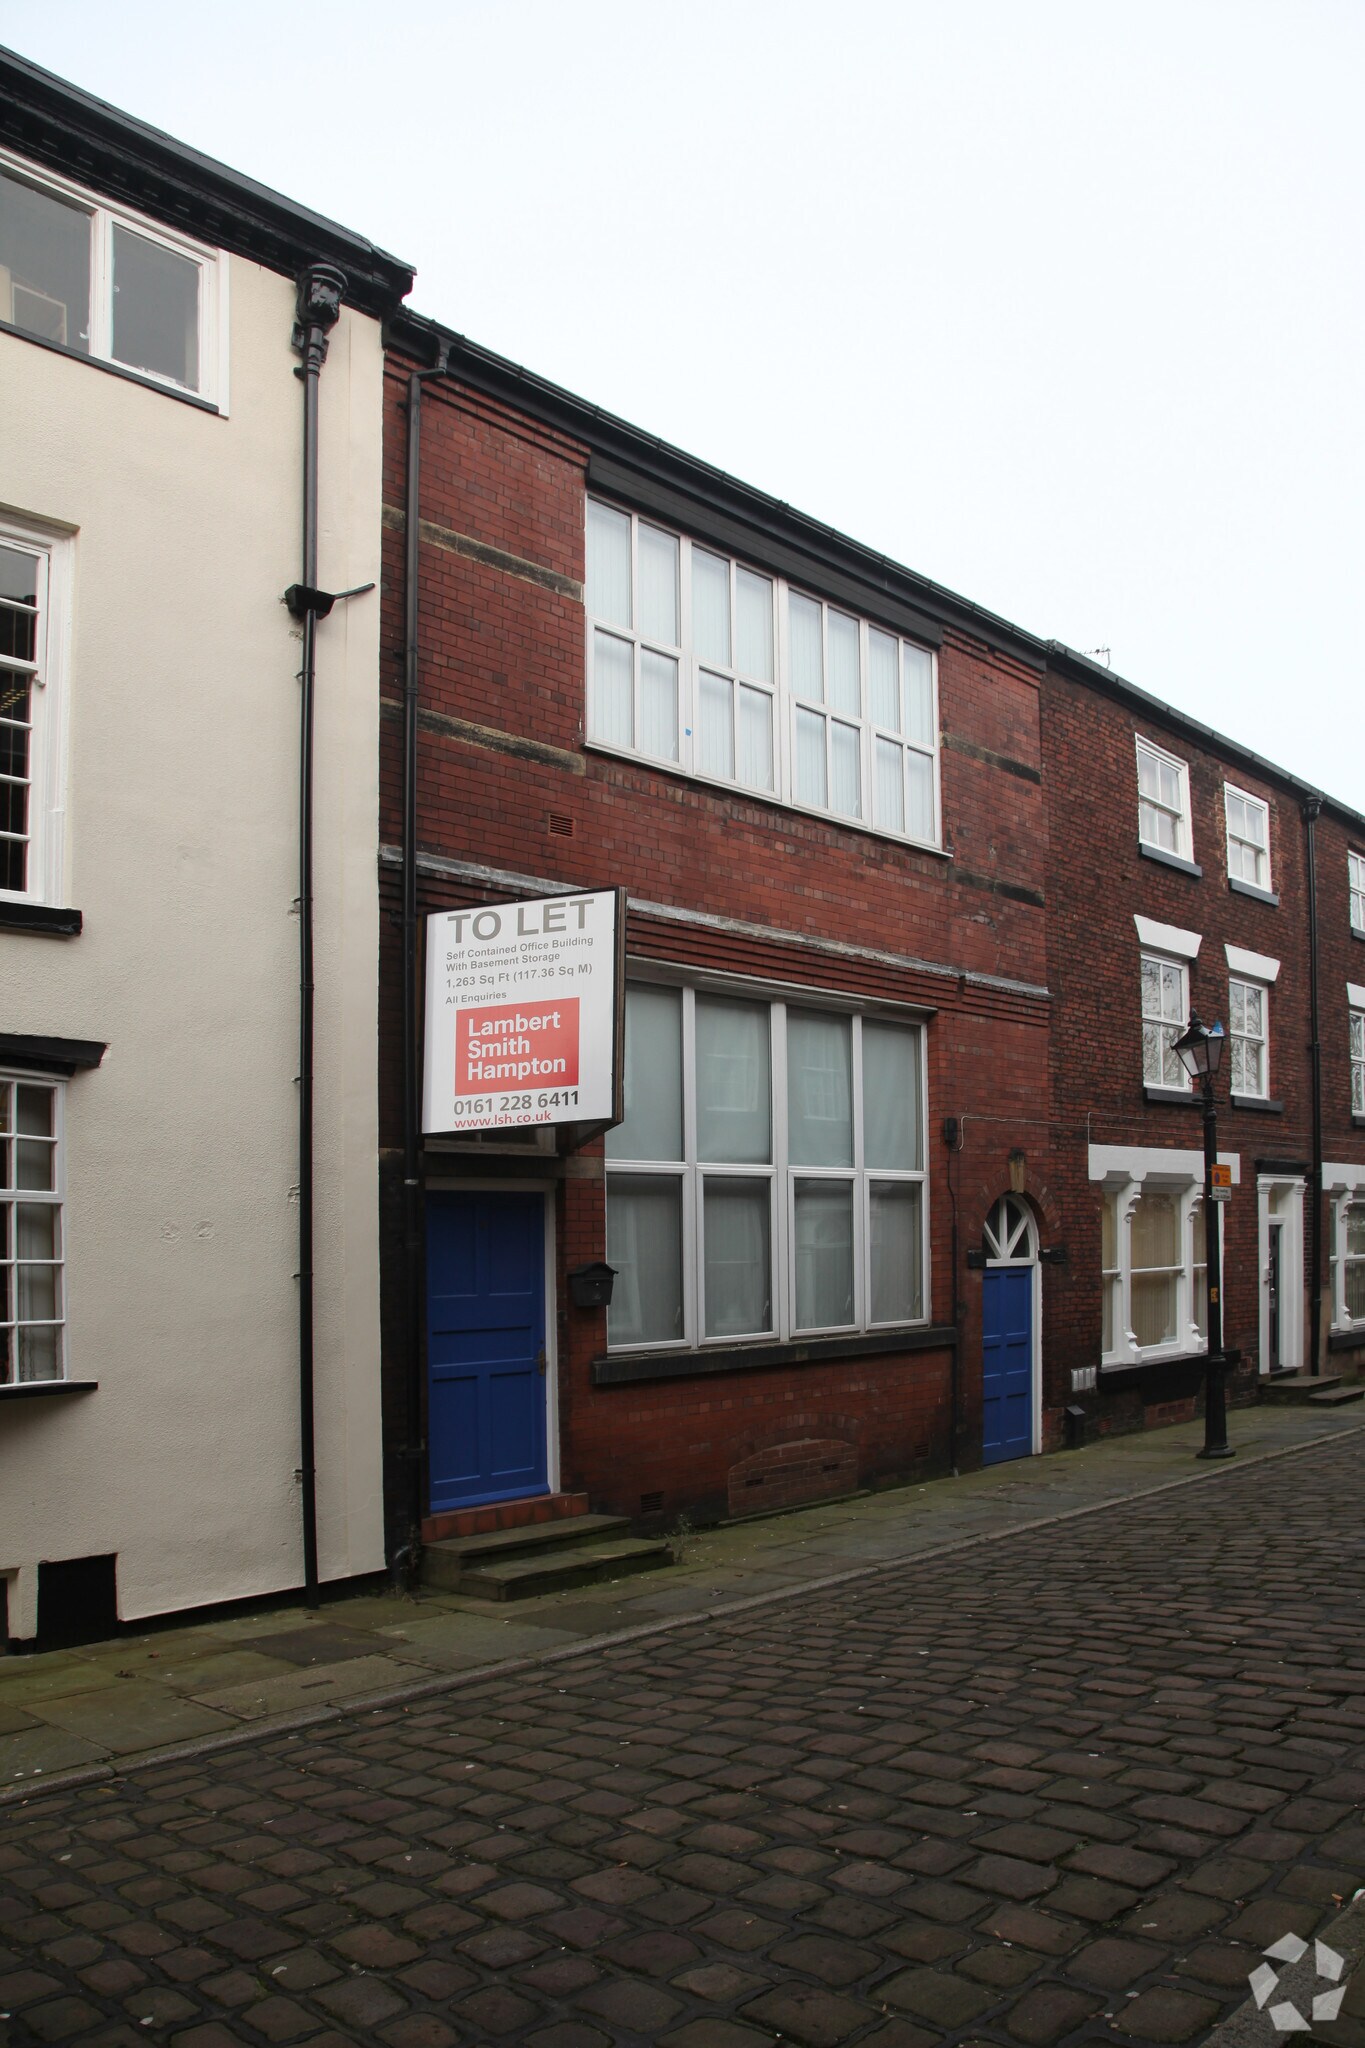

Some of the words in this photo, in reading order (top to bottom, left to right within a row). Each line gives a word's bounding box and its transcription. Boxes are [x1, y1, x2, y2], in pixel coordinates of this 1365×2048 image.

[447, 911, 502, 943] TO
[517, 899, 595, 936] LET
[446, 950, 465, 961] Self
[467, 945, 517, 958] Contained
[519, 942, 549, 952] Office
[552, 936, 594, 948] Building
[446, 963, 468, 972] With
[470, 954, 519, 969] Basement
[521, 952, 560, 964] Storage
[446, 976, 476, 988] 1,263
[479, 974, 495, 985] Sq
[498, 972, 510, 982] Ft
[513, 967, 555, 983] (117.36
[558, 966, 574, 977] Sq
[578, 963, 593, 975] M)
[445, 995, 458, 1004] All
[461, 991, 507, 1004] Enquiries
[468, 1011, 561, 1037] Lambert
[467, 1035, 530, 1059] Smith
[468, 1057, 566, 1081] Hampton
[453, 1098, 493, 1115] 0161
[499, 1094, 532, 1111] 228
[537, 1090, 579, 1108] 6411
[454, 1110, 551, 1128] www.lsh.co.uk
